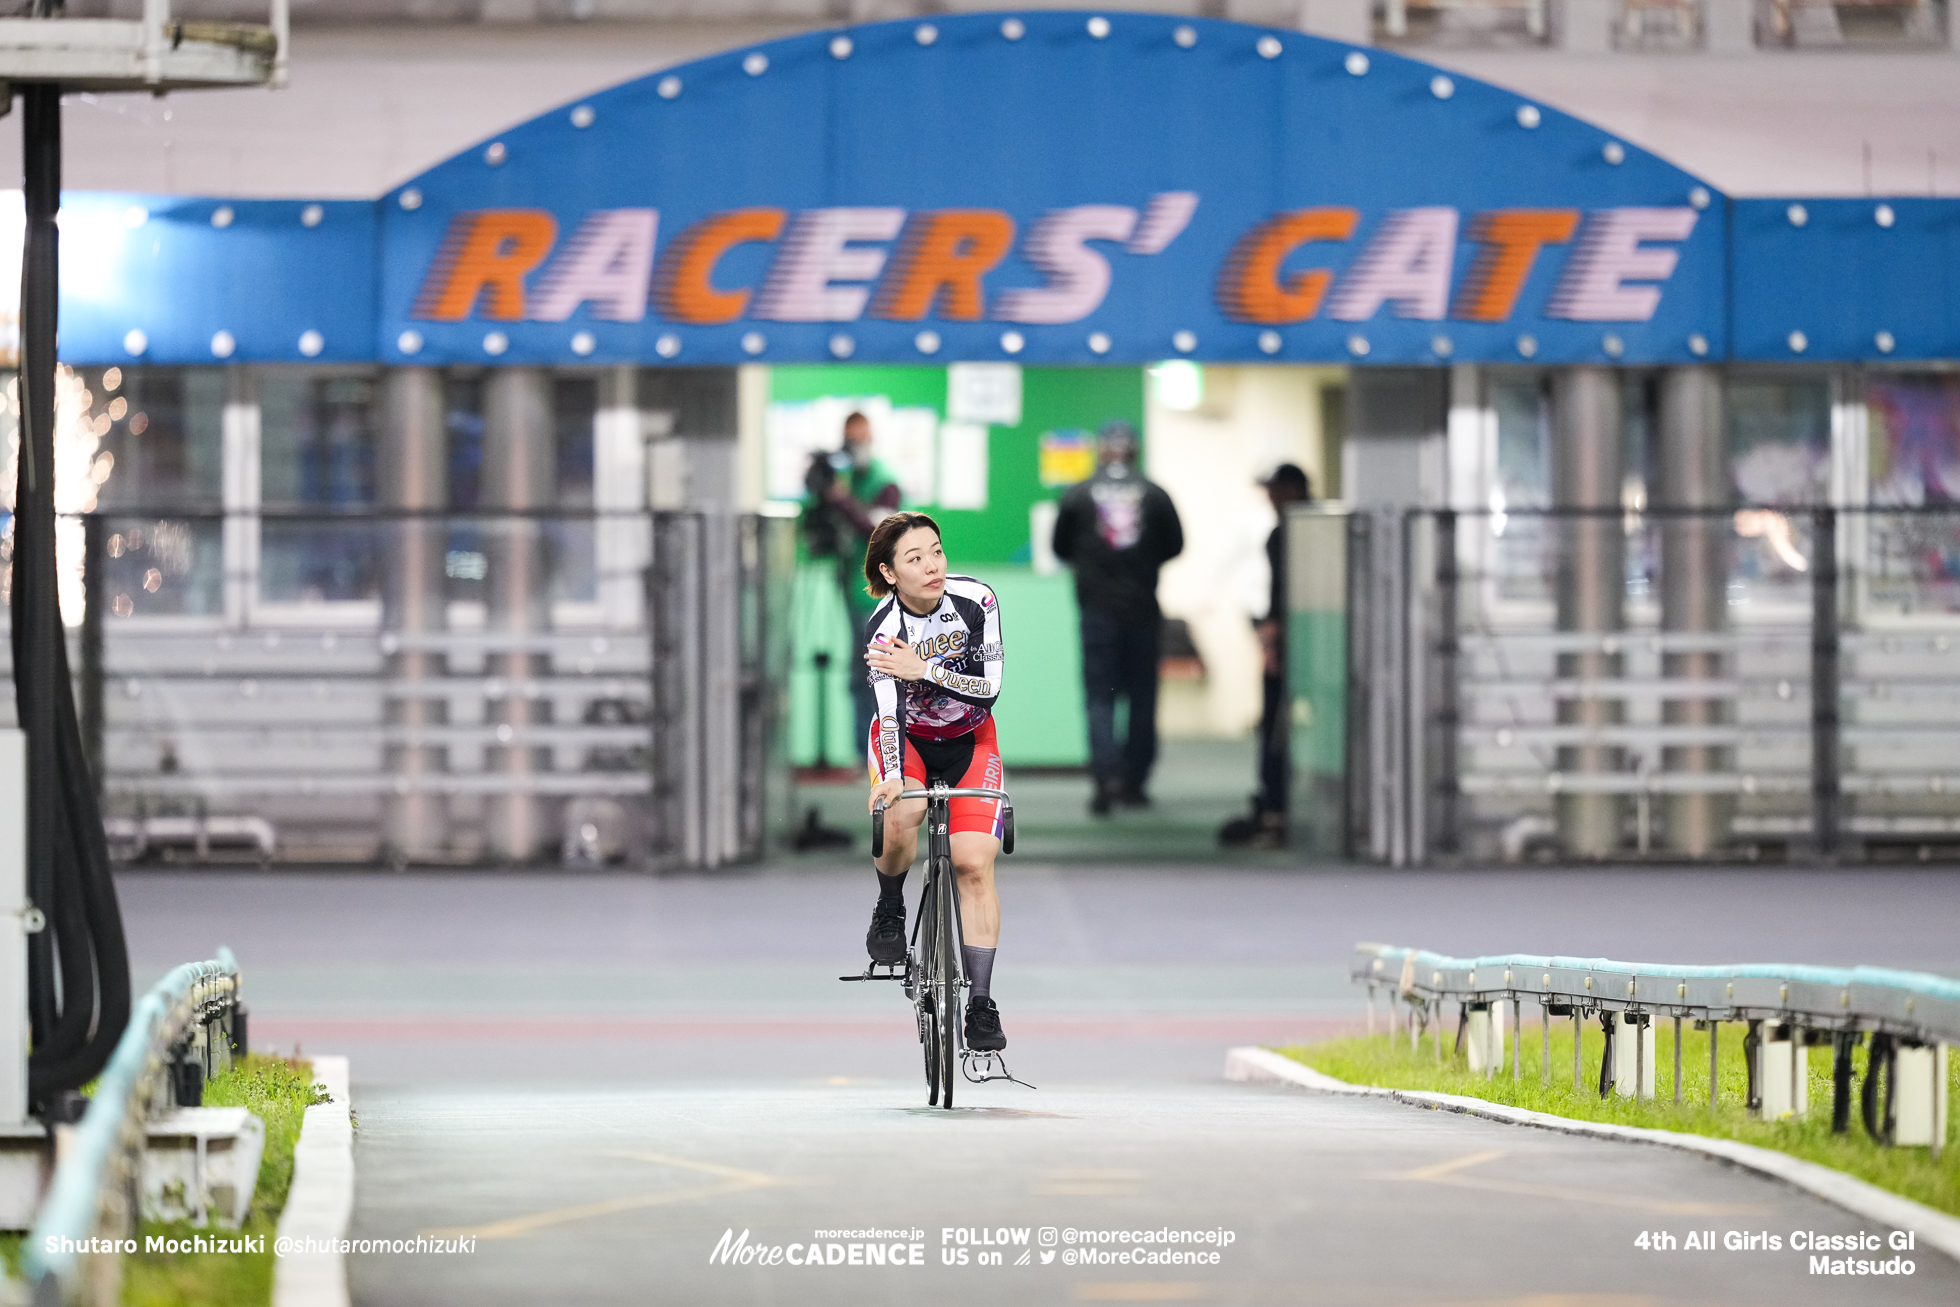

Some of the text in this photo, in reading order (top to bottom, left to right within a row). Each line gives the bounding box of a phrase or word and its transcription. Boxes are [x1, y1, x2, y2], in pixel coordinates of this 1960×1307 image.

[411, 191, 1699, 324] RACERS' GATE
[931, 664, 991, 696] Queen
[881, 716, 900, 773] Queen
